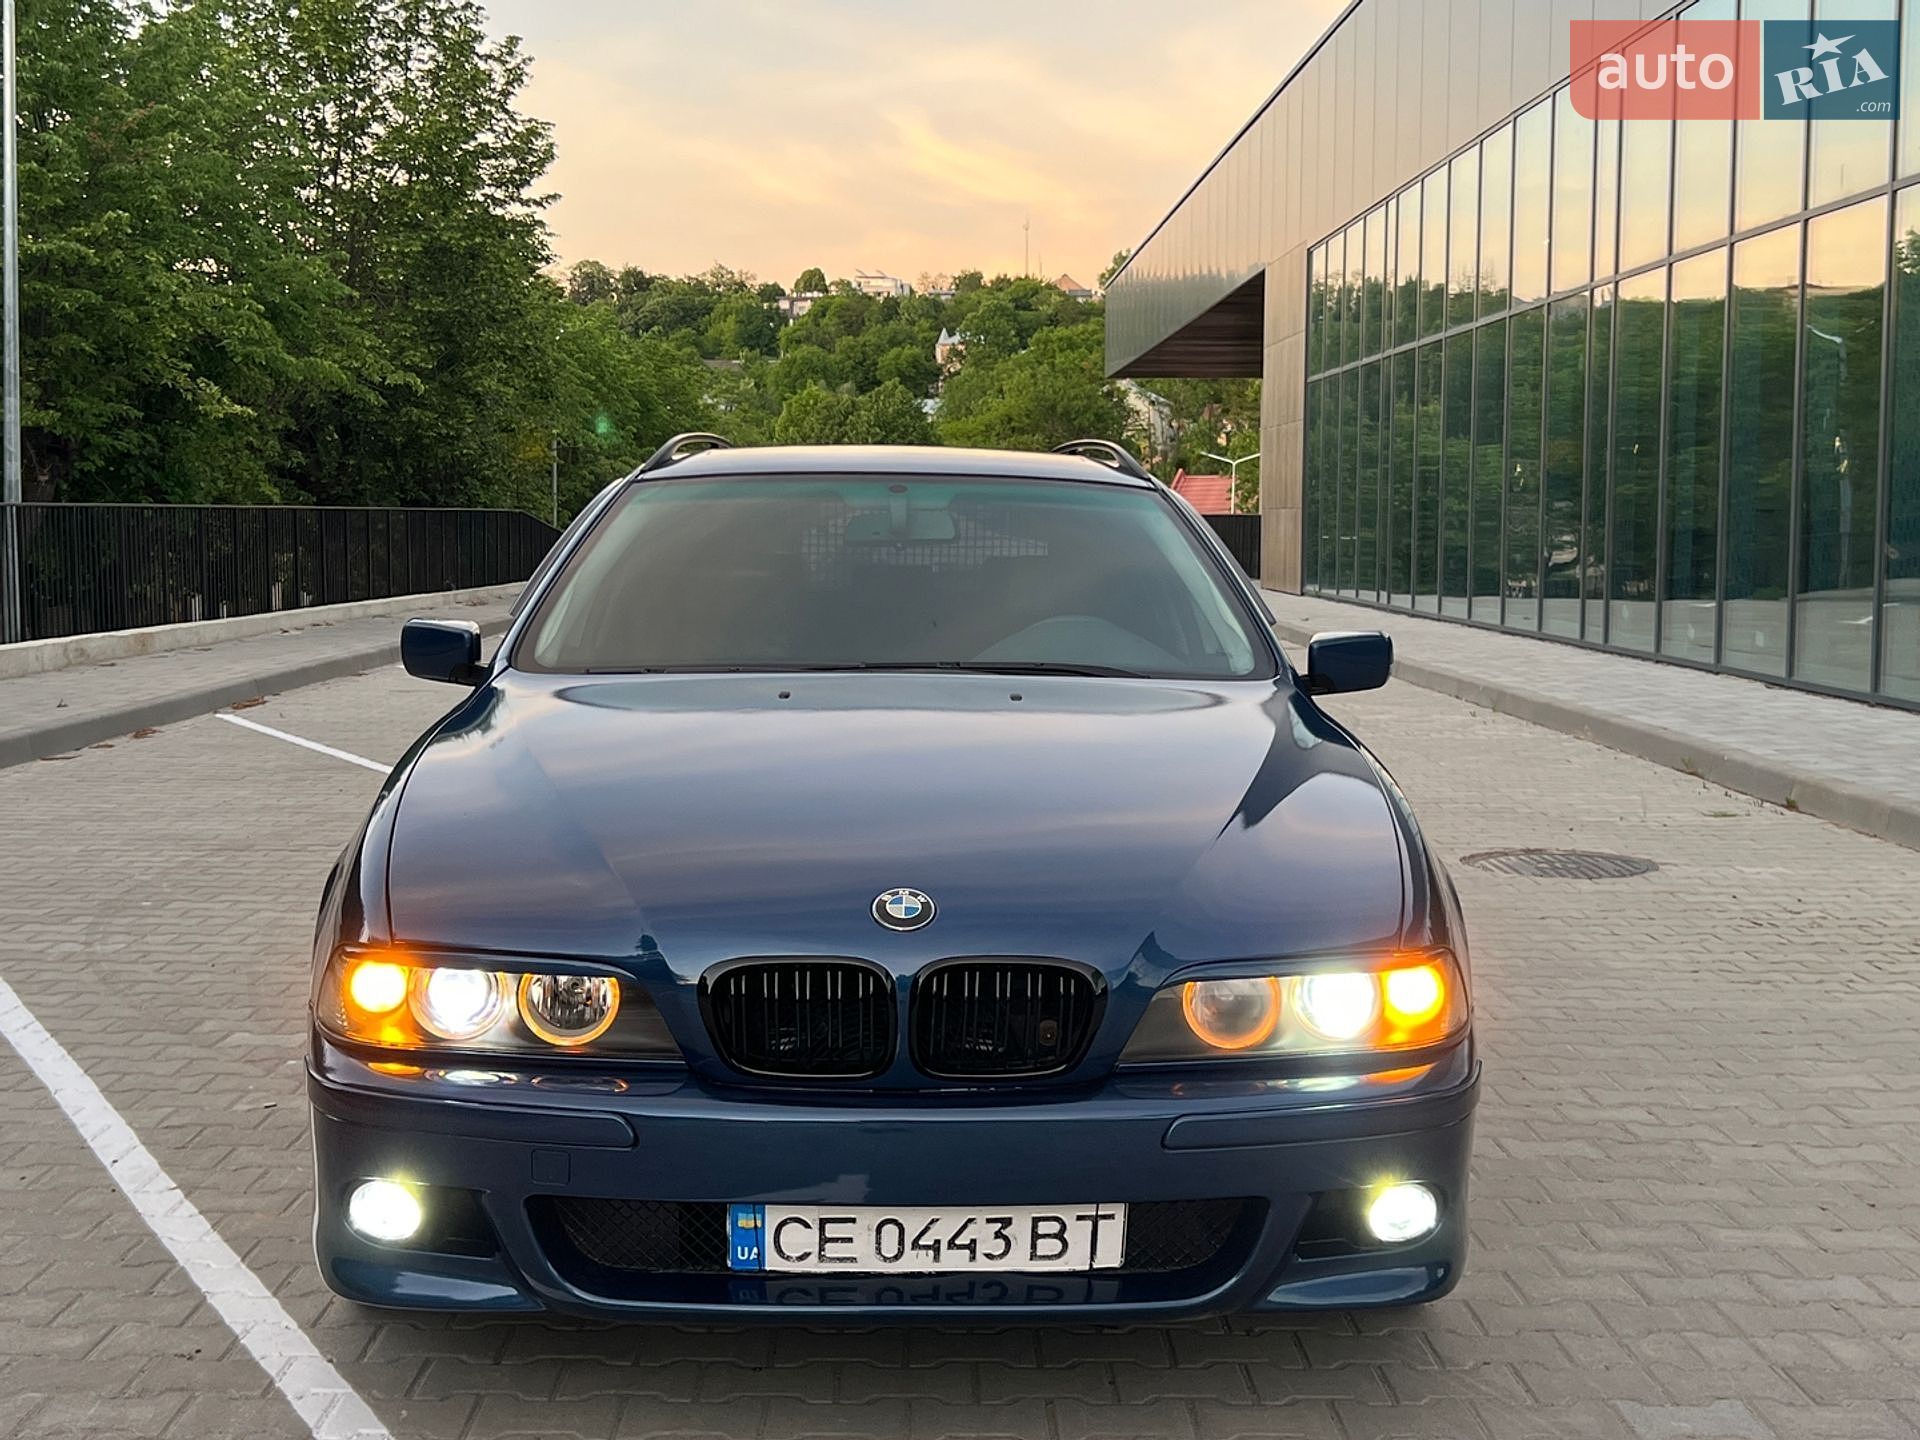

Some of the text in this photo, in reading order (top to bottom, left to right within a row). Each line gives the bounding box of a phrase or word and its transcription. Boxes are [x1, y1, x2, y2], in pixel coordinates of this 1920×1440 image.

[736, 1246, 761, 1261] UA
[773, 1212, 1117, 1264] CE 0443 BT
